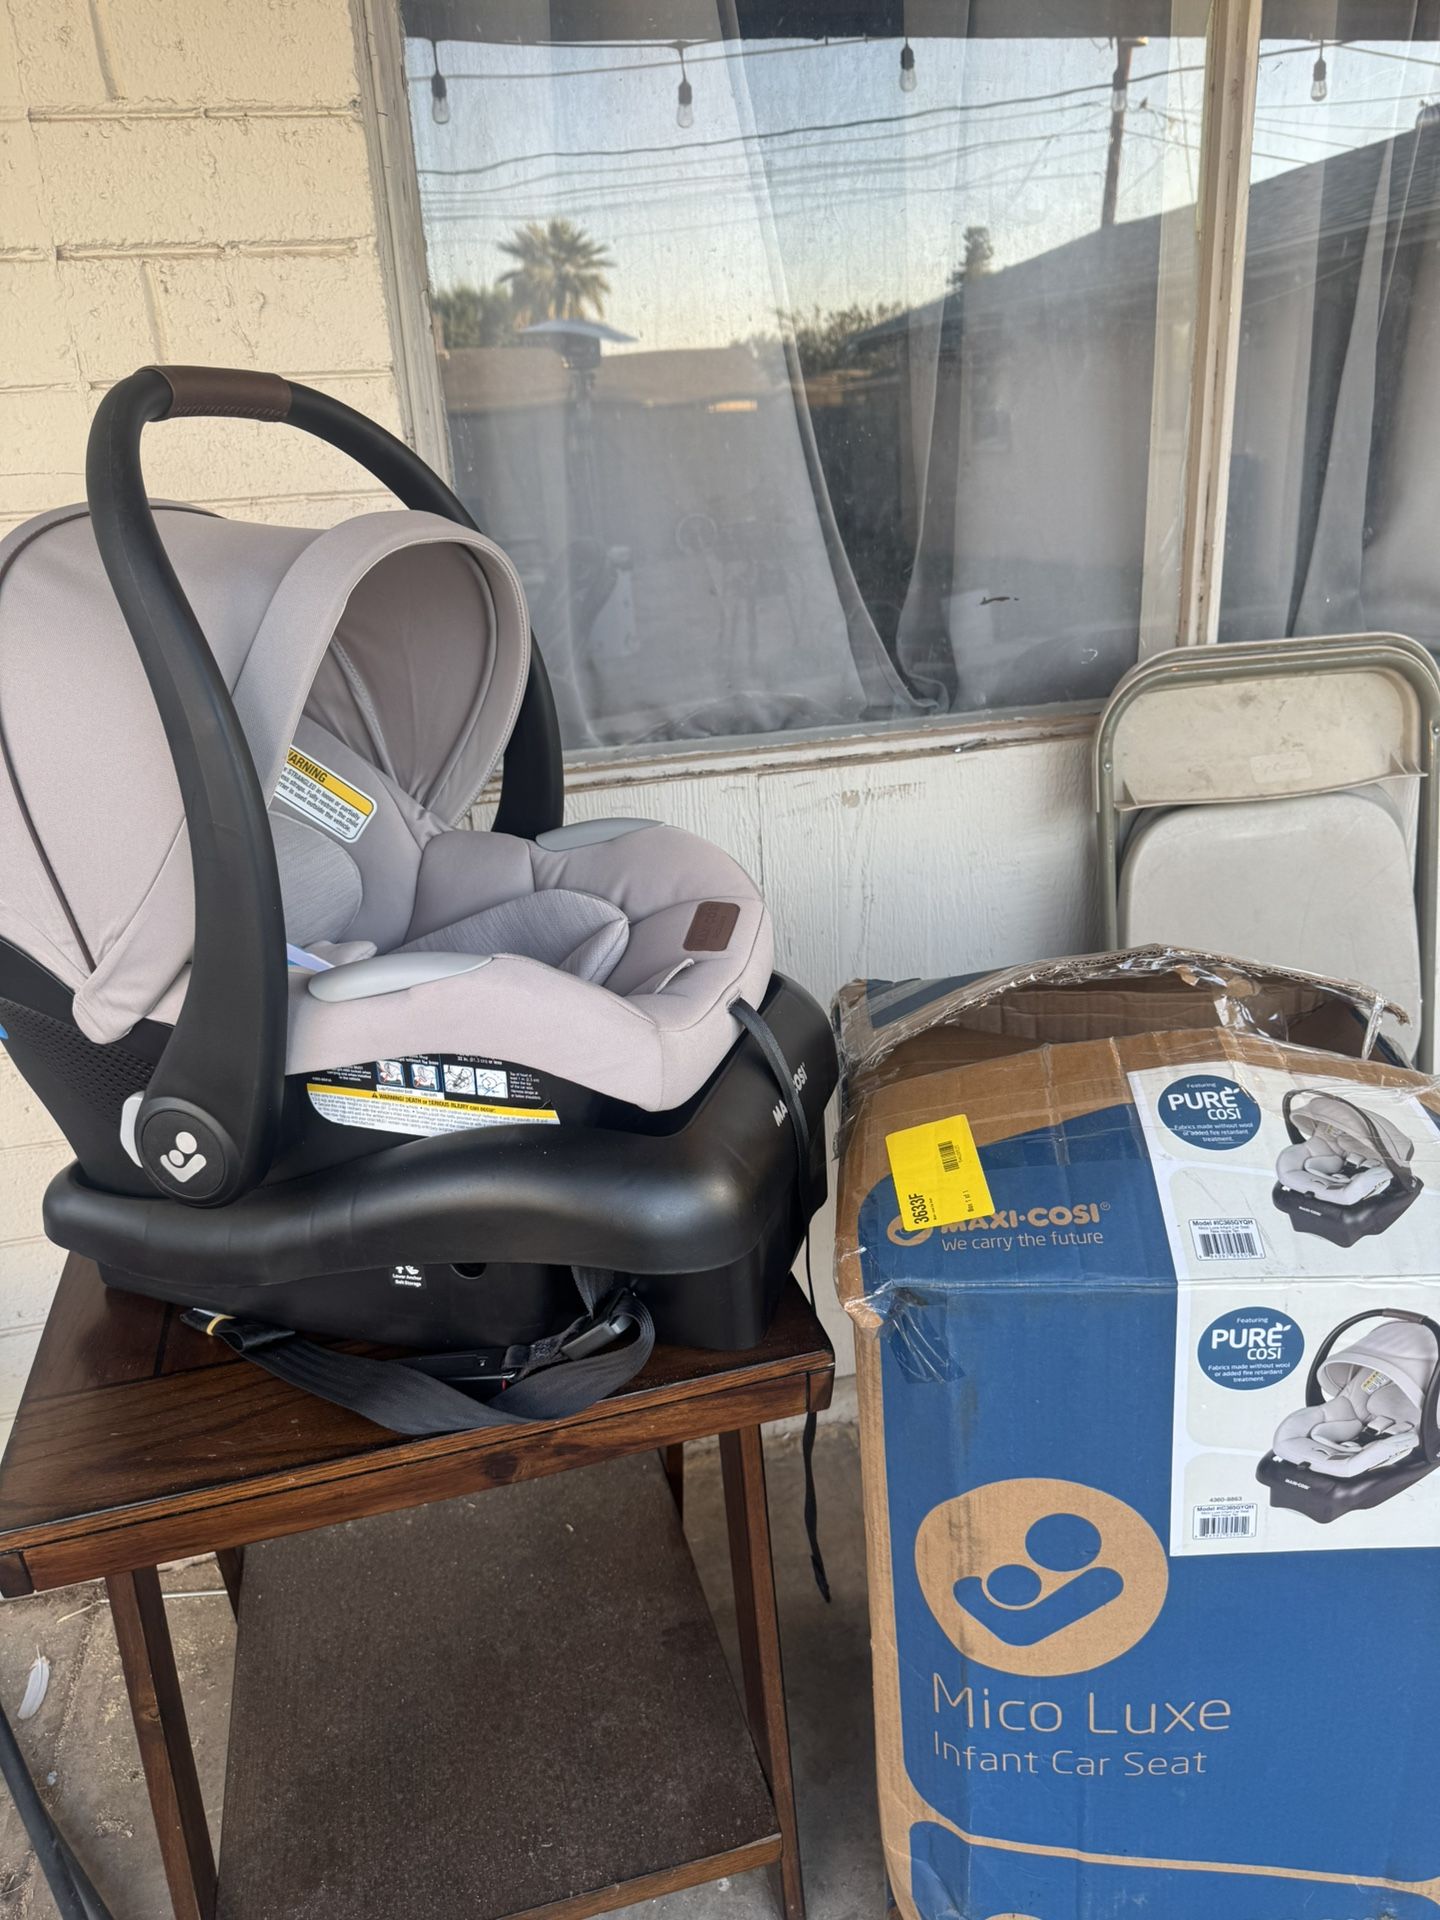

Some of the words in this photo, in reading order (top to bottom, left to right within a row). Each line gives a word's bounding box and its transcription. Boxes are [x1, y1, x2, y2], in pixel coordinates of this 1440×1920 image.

[288, 769, 316, 791] STRANGLED
[341, 805, 361, 820] partially
[307, 800, 325, 814] outside
[307, 791, 318, 801] Fully
[347, 817, 358, 827] child
[1167, 1089, 1238, 1111] PURE
[1207, 1108, 1242, 1120] COSI
[908, 1193, 929, 1224] 3633F
[942, 1238, 967, 1251] We
[971, 1236, 1012, 1251] carry
[1016, 1232, 1046, 1247] the
[1050, 1231, 1104, 1245] future
[1211, 1326, 1283, 1349] PURE
[1247, 1347, 1281, 1360] COSI
[933, 1672, 1063, 1732] Mico
[1089, 1692, 1231, 1734] Luxe
[934, 1731, 1039, 1774] Infant
[1052, 1750, 1111, 1776] Car
[1124, 1751, 1207, 1776] Seat
